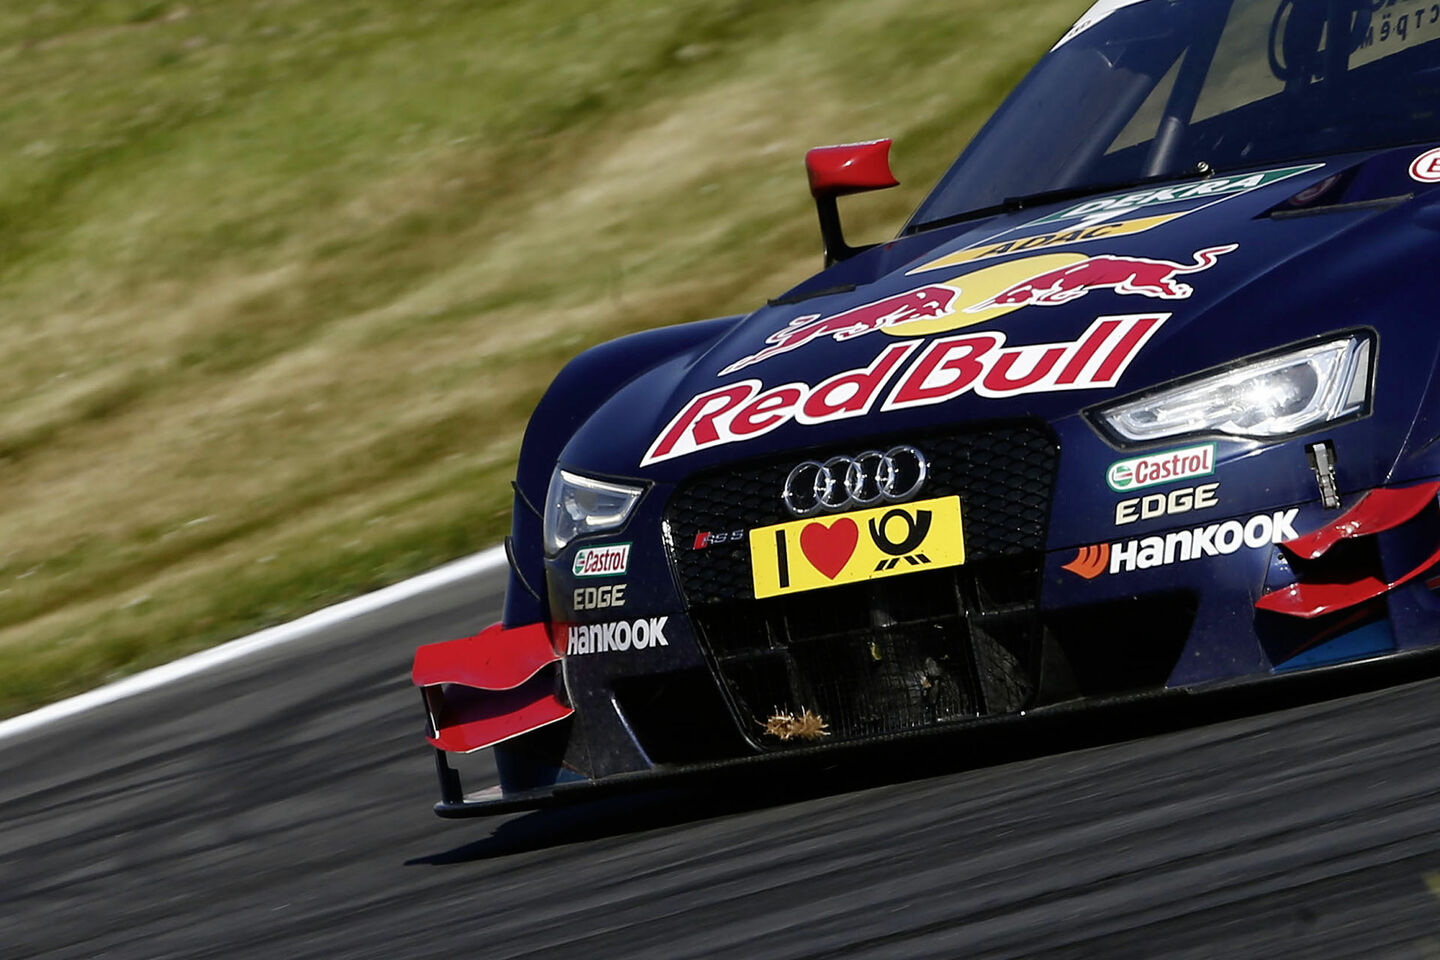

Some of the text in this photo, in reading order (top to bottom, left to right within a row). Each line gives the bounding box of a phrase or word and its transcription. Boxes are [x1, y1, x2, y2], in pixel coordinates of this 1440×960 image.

[1060, 173, 1265, 219] DEKRA
[639, 312, 1173, 468] Red Bull
[1134, 453, 1211, 483] Castrol
[1114, 482, 1220, 526] EDGE
[584, 547, 626, 573] Castrol
[775, 529, 790, 588] I
[573, 583, 627, 611] EDGE
